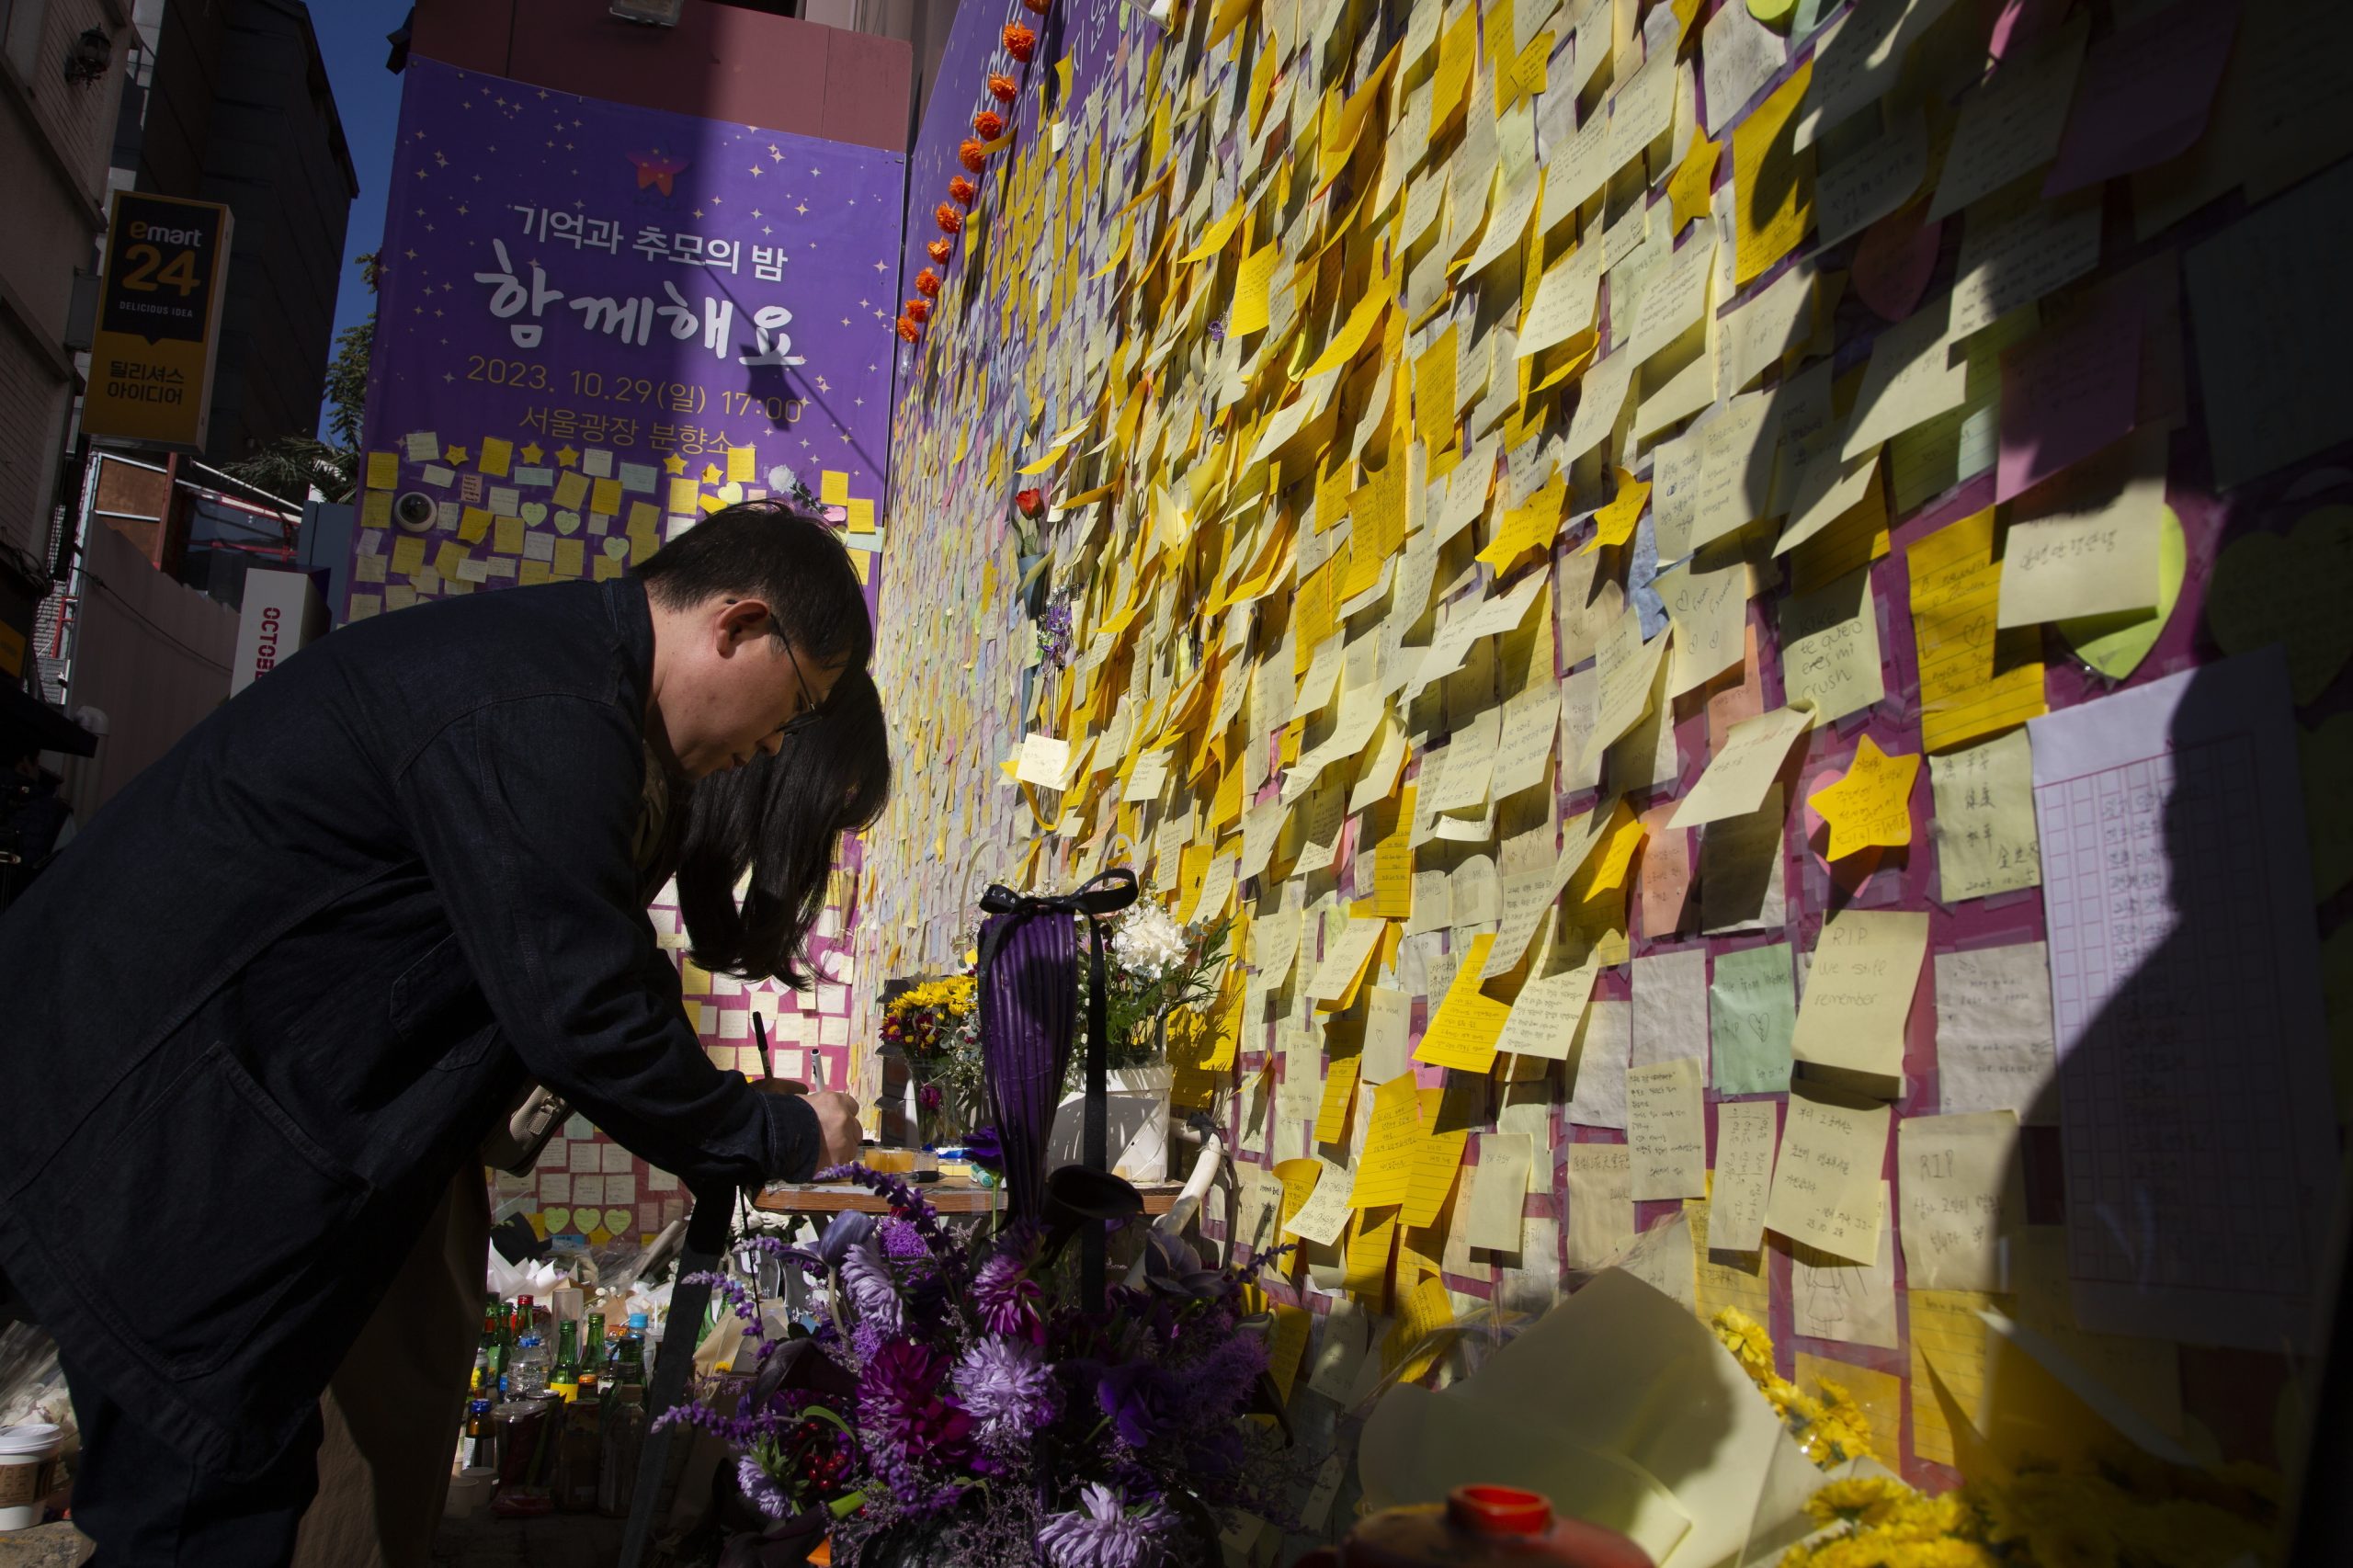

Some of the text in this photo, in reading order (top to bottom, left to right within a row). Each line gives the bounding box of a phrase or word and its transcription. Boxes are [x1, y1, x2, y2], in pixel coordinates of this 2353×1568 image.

[129, 220, 203, 247] emart
[514, 204, 789, 282] 기억과 추모의 밤
[120, 243, 202, 298] 24
[119, 301, 194, 318] DELICIOUS IDEA
[473, 238, 805, 367] 함께해요
[107, 381, 183, 405] 아이디어
[109, 360, 185, 384] 딜리셔스
[466, 355, 802, 424] 2023. 10.29(일) 17:00
[519, 404, 733, 455] 서울광장 분향소
[255, 607, 281, 679] OCTOB
[1832, 926, 1869, 947] RIP
[1919, 1148, 1955, 1182] RIP
